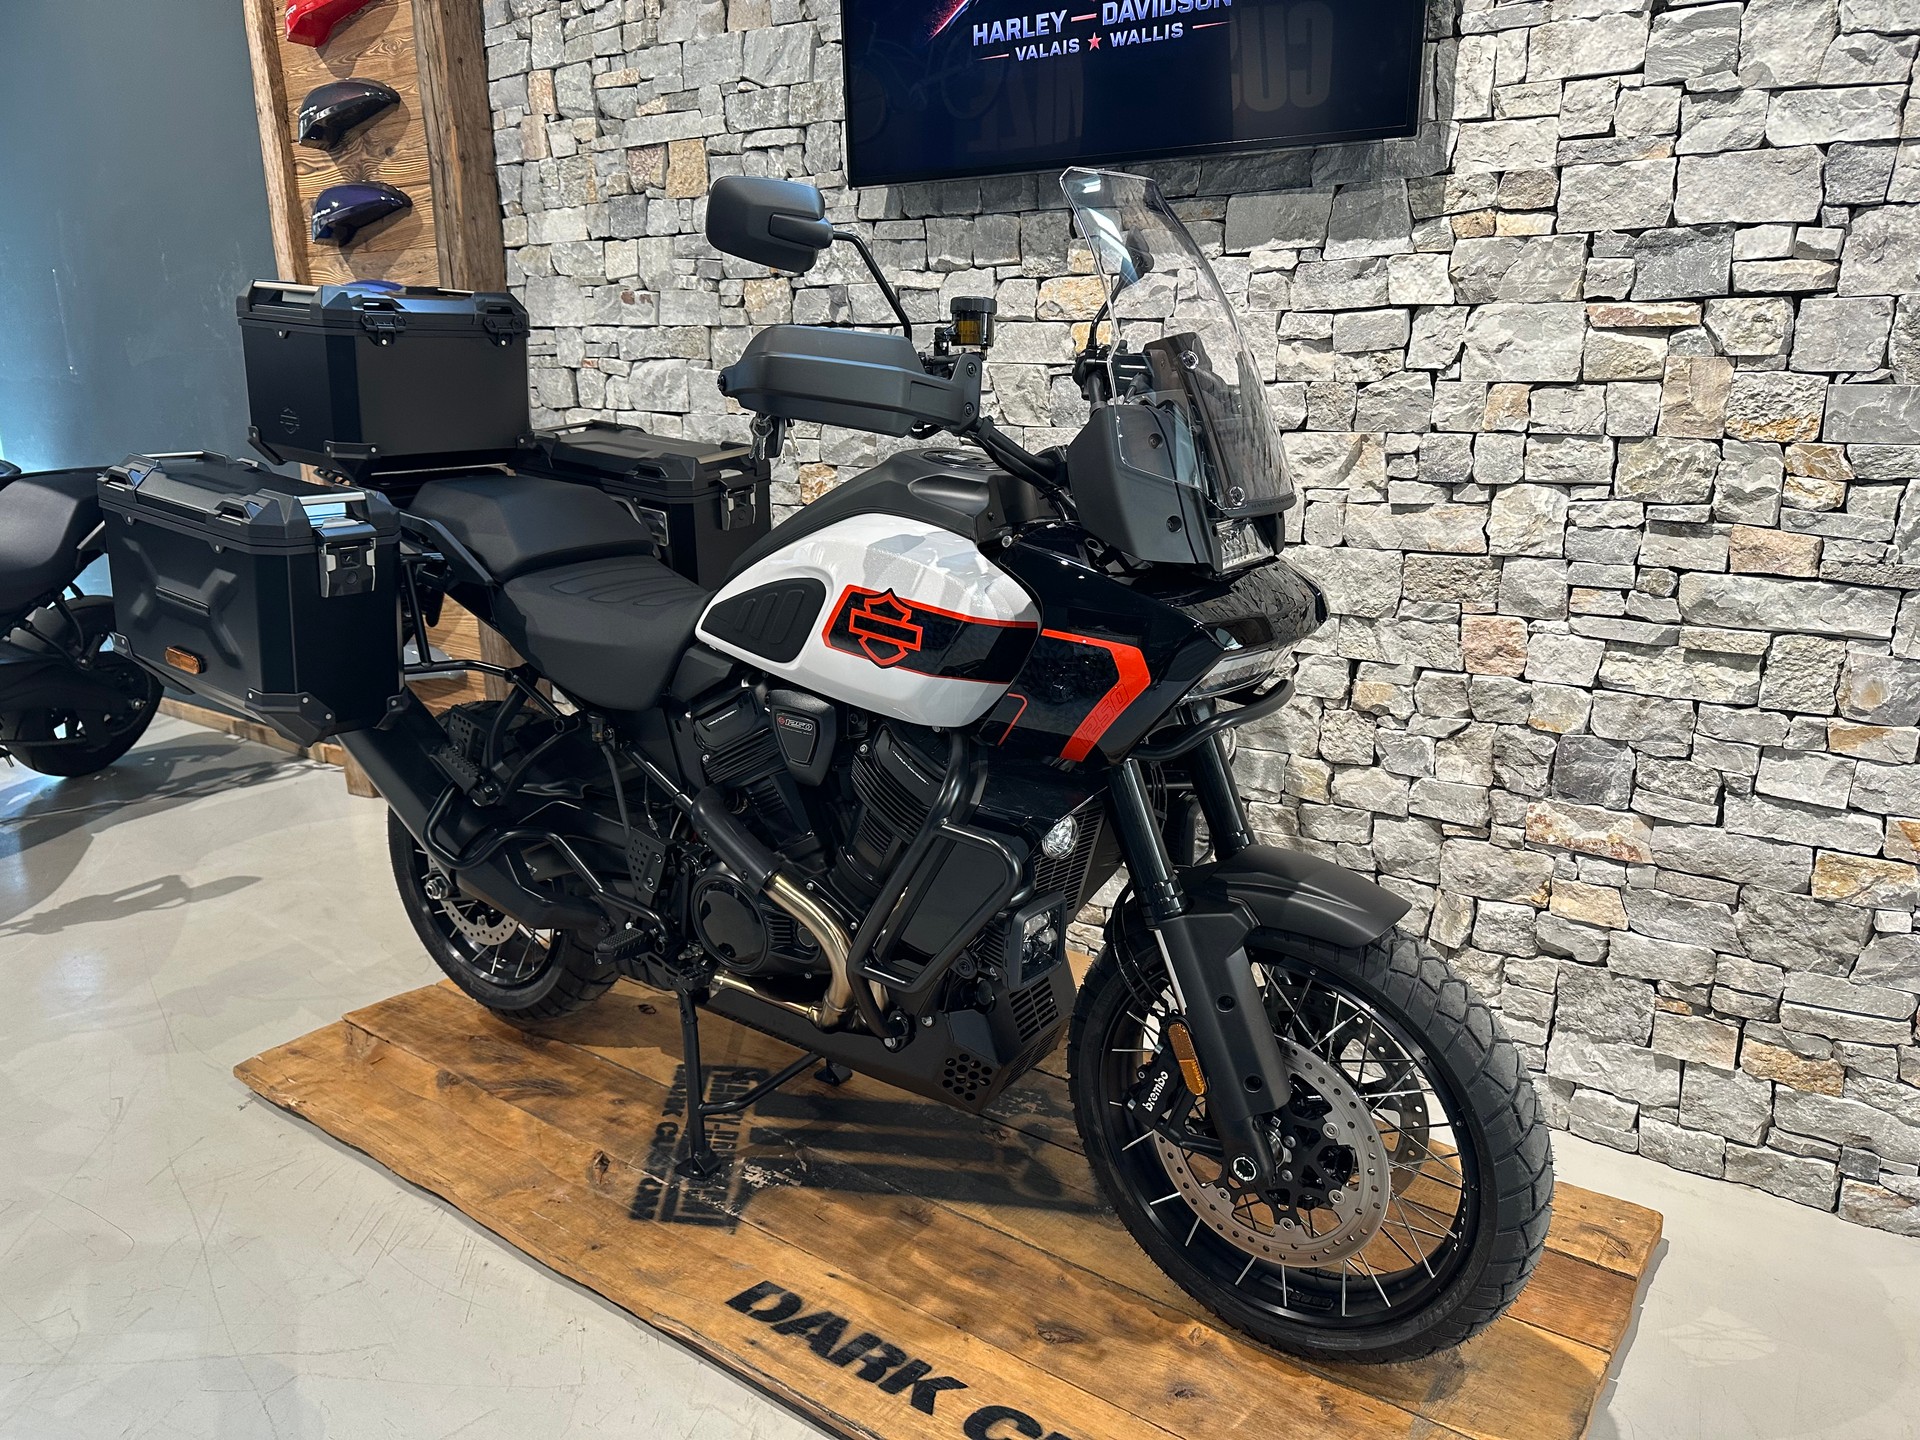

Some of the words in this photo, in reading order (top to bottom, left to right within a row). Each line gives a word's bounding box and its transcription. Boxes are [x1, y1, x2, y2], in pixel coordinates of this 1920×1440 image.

[973, 10, 1068, 46] HARLEY
[1015, 38, 1080, 61] VALAIS
[1110, 22, 1184, 48] WALLIS
[1076, 684, 1130, 749] 1250
[1141, 1070, 1169, 1112] brembo
[724, 1280, 969, 1416] DARK
[963, 1405, 1076, 1440] C
